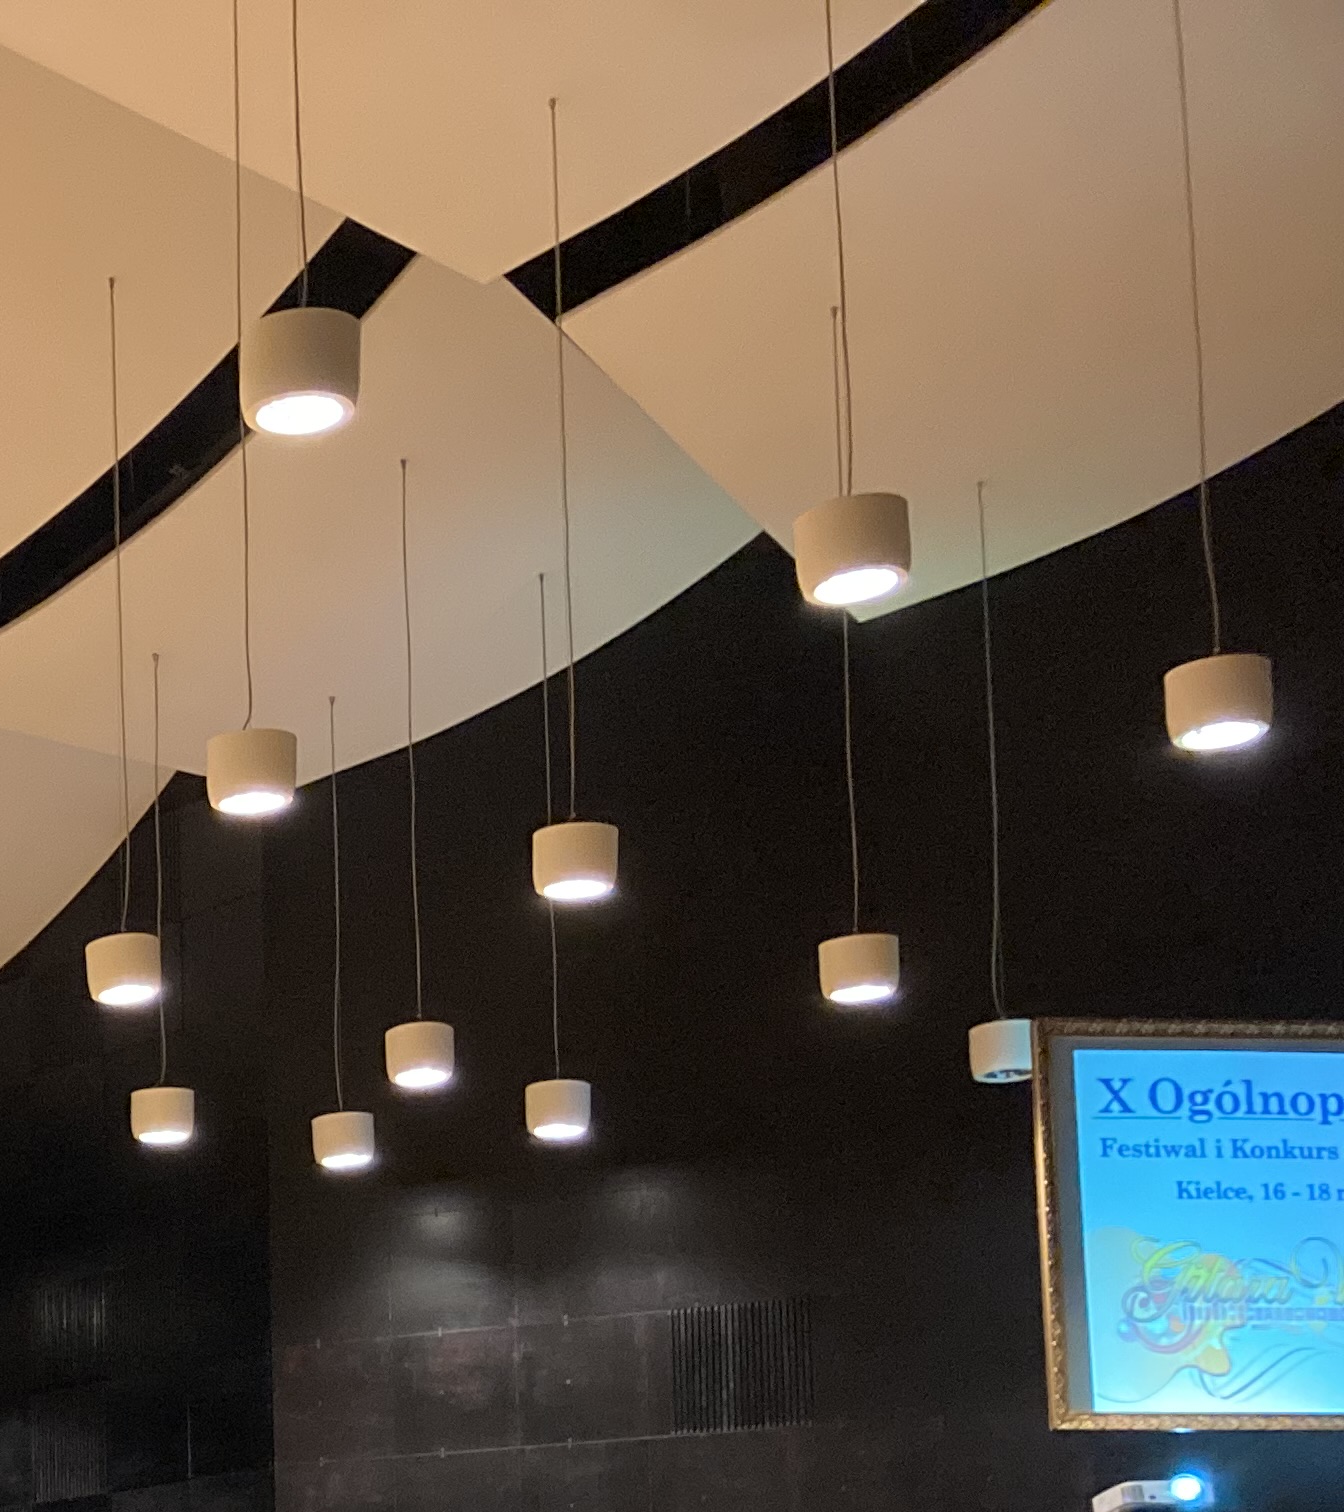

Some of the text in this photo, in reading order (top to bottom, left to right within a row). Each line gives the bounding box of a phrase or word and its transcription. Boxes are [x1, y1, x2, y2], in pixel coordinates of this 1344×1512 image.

[1096, 1077, 1344, 1125] X Ogólnop
[1099, 1137, 1340, 1160] Festiwal i Konkurs
[1176, 1180, 1254, 1202] Kielce,
[1261, 1183, 1286, 1201] 16
[1307, 1183, 1331, 1202] 18
